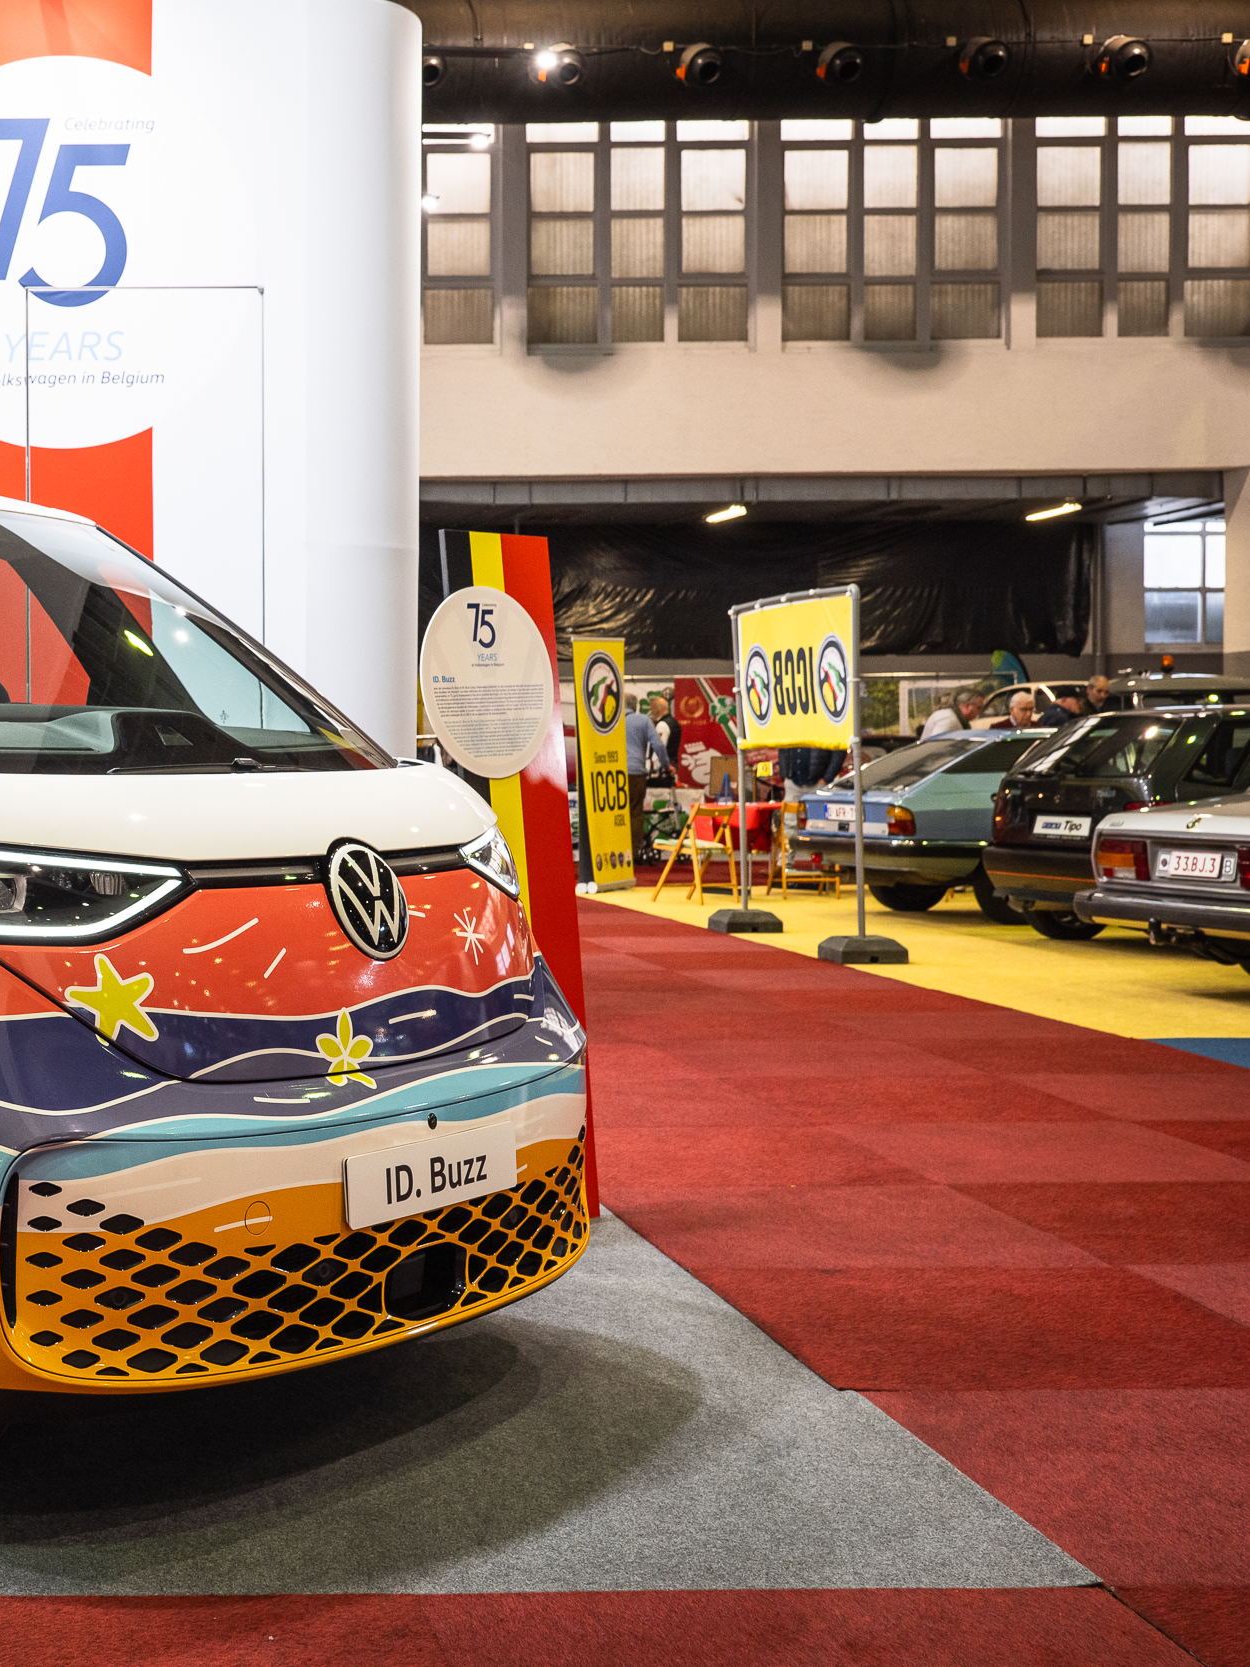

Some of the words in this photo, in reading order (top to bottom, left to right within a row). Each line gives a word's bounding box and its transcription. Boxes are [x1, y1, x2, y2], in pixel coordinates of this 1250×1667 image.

[64, 117, 155, 133] Celebrating
[5, 331, 125, 362] YEARS
[82, 371, 95, 384] in
[101, 371, 165, 388] Belgium
[467, 603, 496, 648] 75
[477, 653, 498, 661] YEARS
[442, 675, 455, 683] Buzz
[590, 770, 628, 813] ICCB
[1064, 820, 1082, 832] Tipo
[385, 1164, 422, 1205] ID.
[430, 1154, 488, 1194] Buzz
